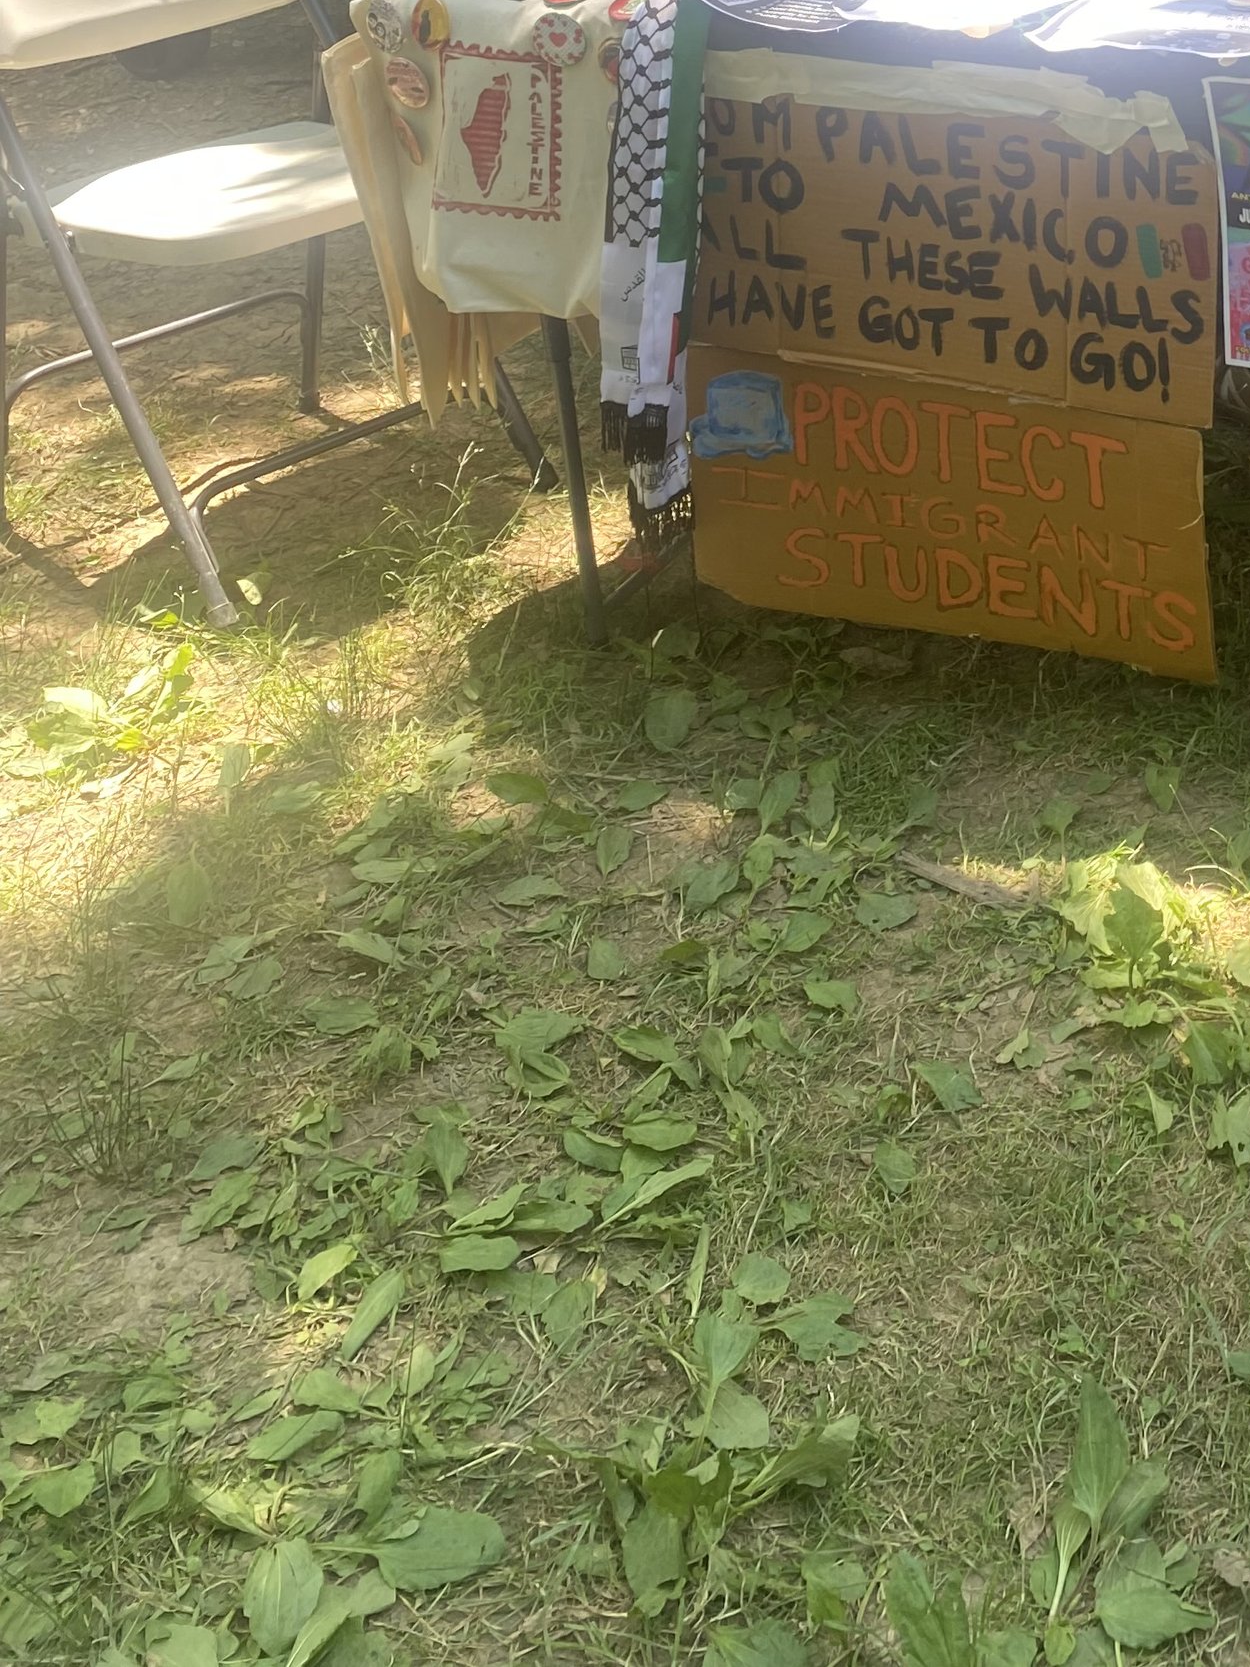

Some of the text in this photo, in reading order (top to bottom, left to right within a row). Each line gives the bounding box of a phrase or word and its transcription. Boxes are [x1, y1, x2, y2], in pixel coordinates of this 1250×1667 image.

[721, 156, 1129, 268] TO MEXICO
[816, 106, 1199, 205] PALESTINE
[707, 270, 1171, 404] HAVE GOT TO GO!
[842, 228, 1004, 300] THESE
[1030, 264, 1204, 345] WALLS
[793, 382, 1130, 510] PROTECT
[711, 466, 1171, 581] IMMIGRANT
[777, 527, 1197, 653] STUDENTS
